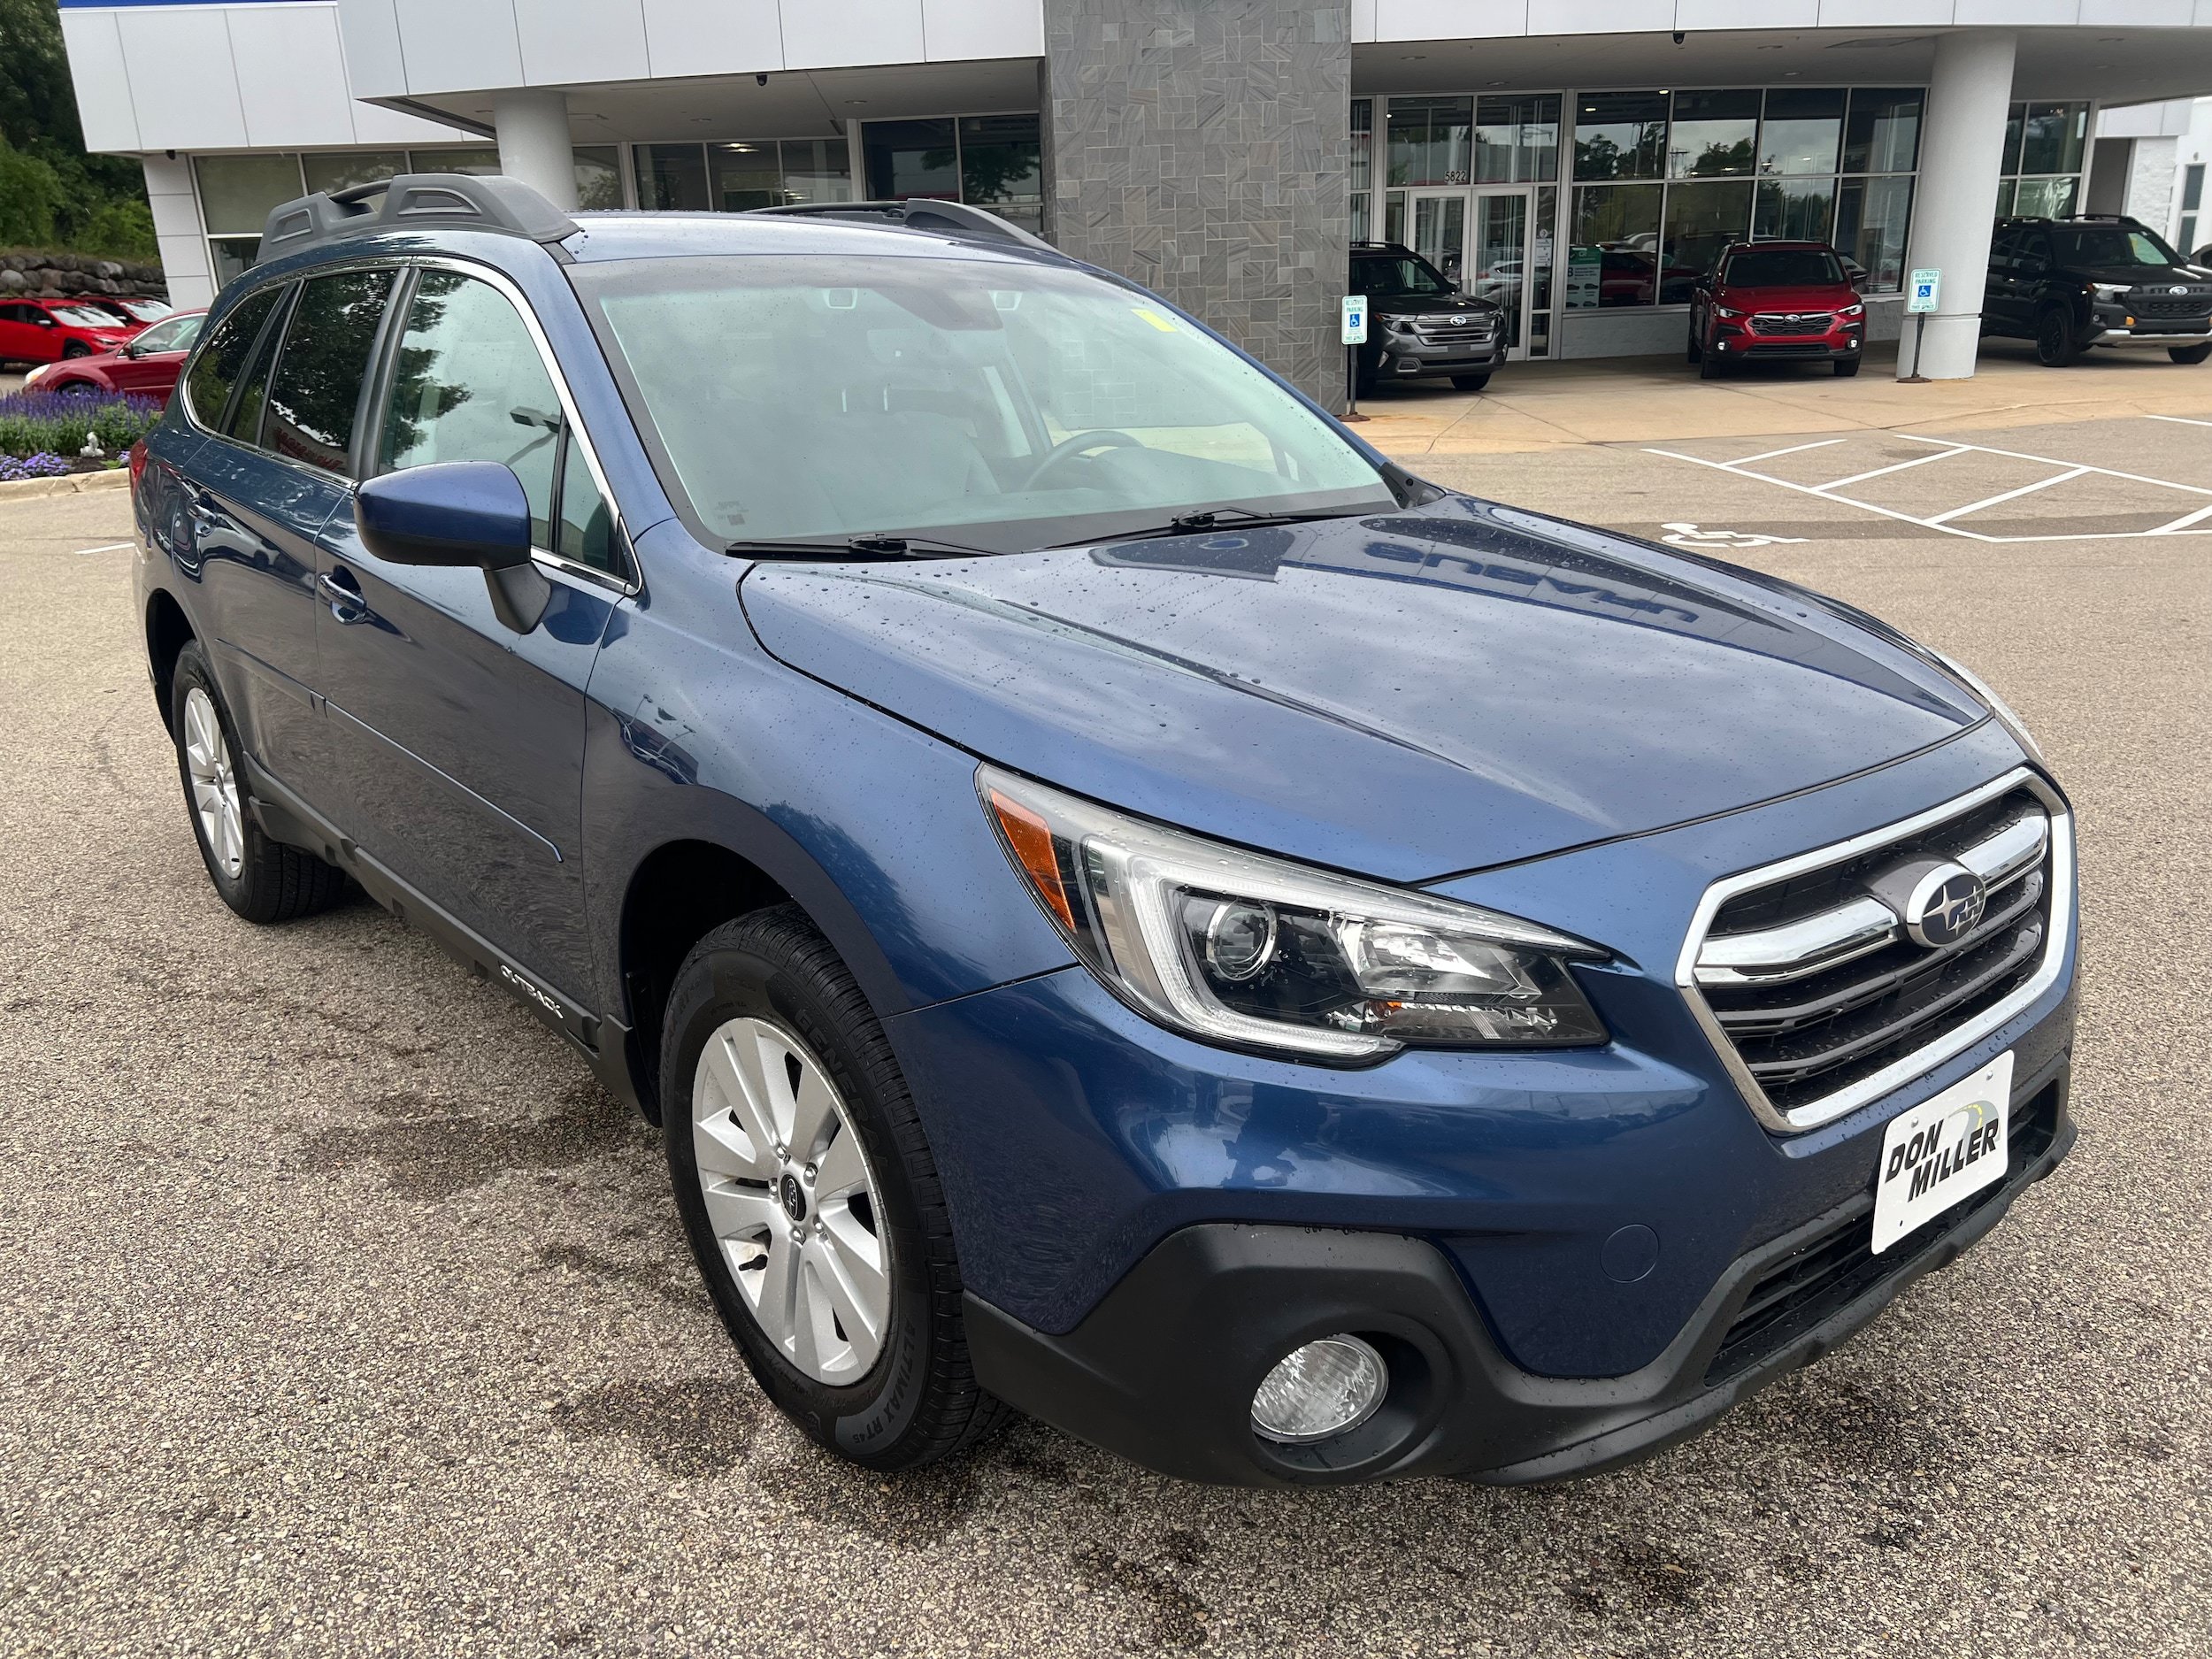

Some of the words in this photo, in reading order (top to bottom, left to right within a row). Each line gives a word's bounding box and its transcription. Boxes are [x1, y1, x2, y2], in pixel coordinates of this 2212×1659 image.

[1445, 171, 1466, 182] 5822
[1885, 1118, 1944, 1184] DON
[1907, 1118, 2000, 1203] MILLER
[883, 1320, 916, 1423] ALTIMAX
